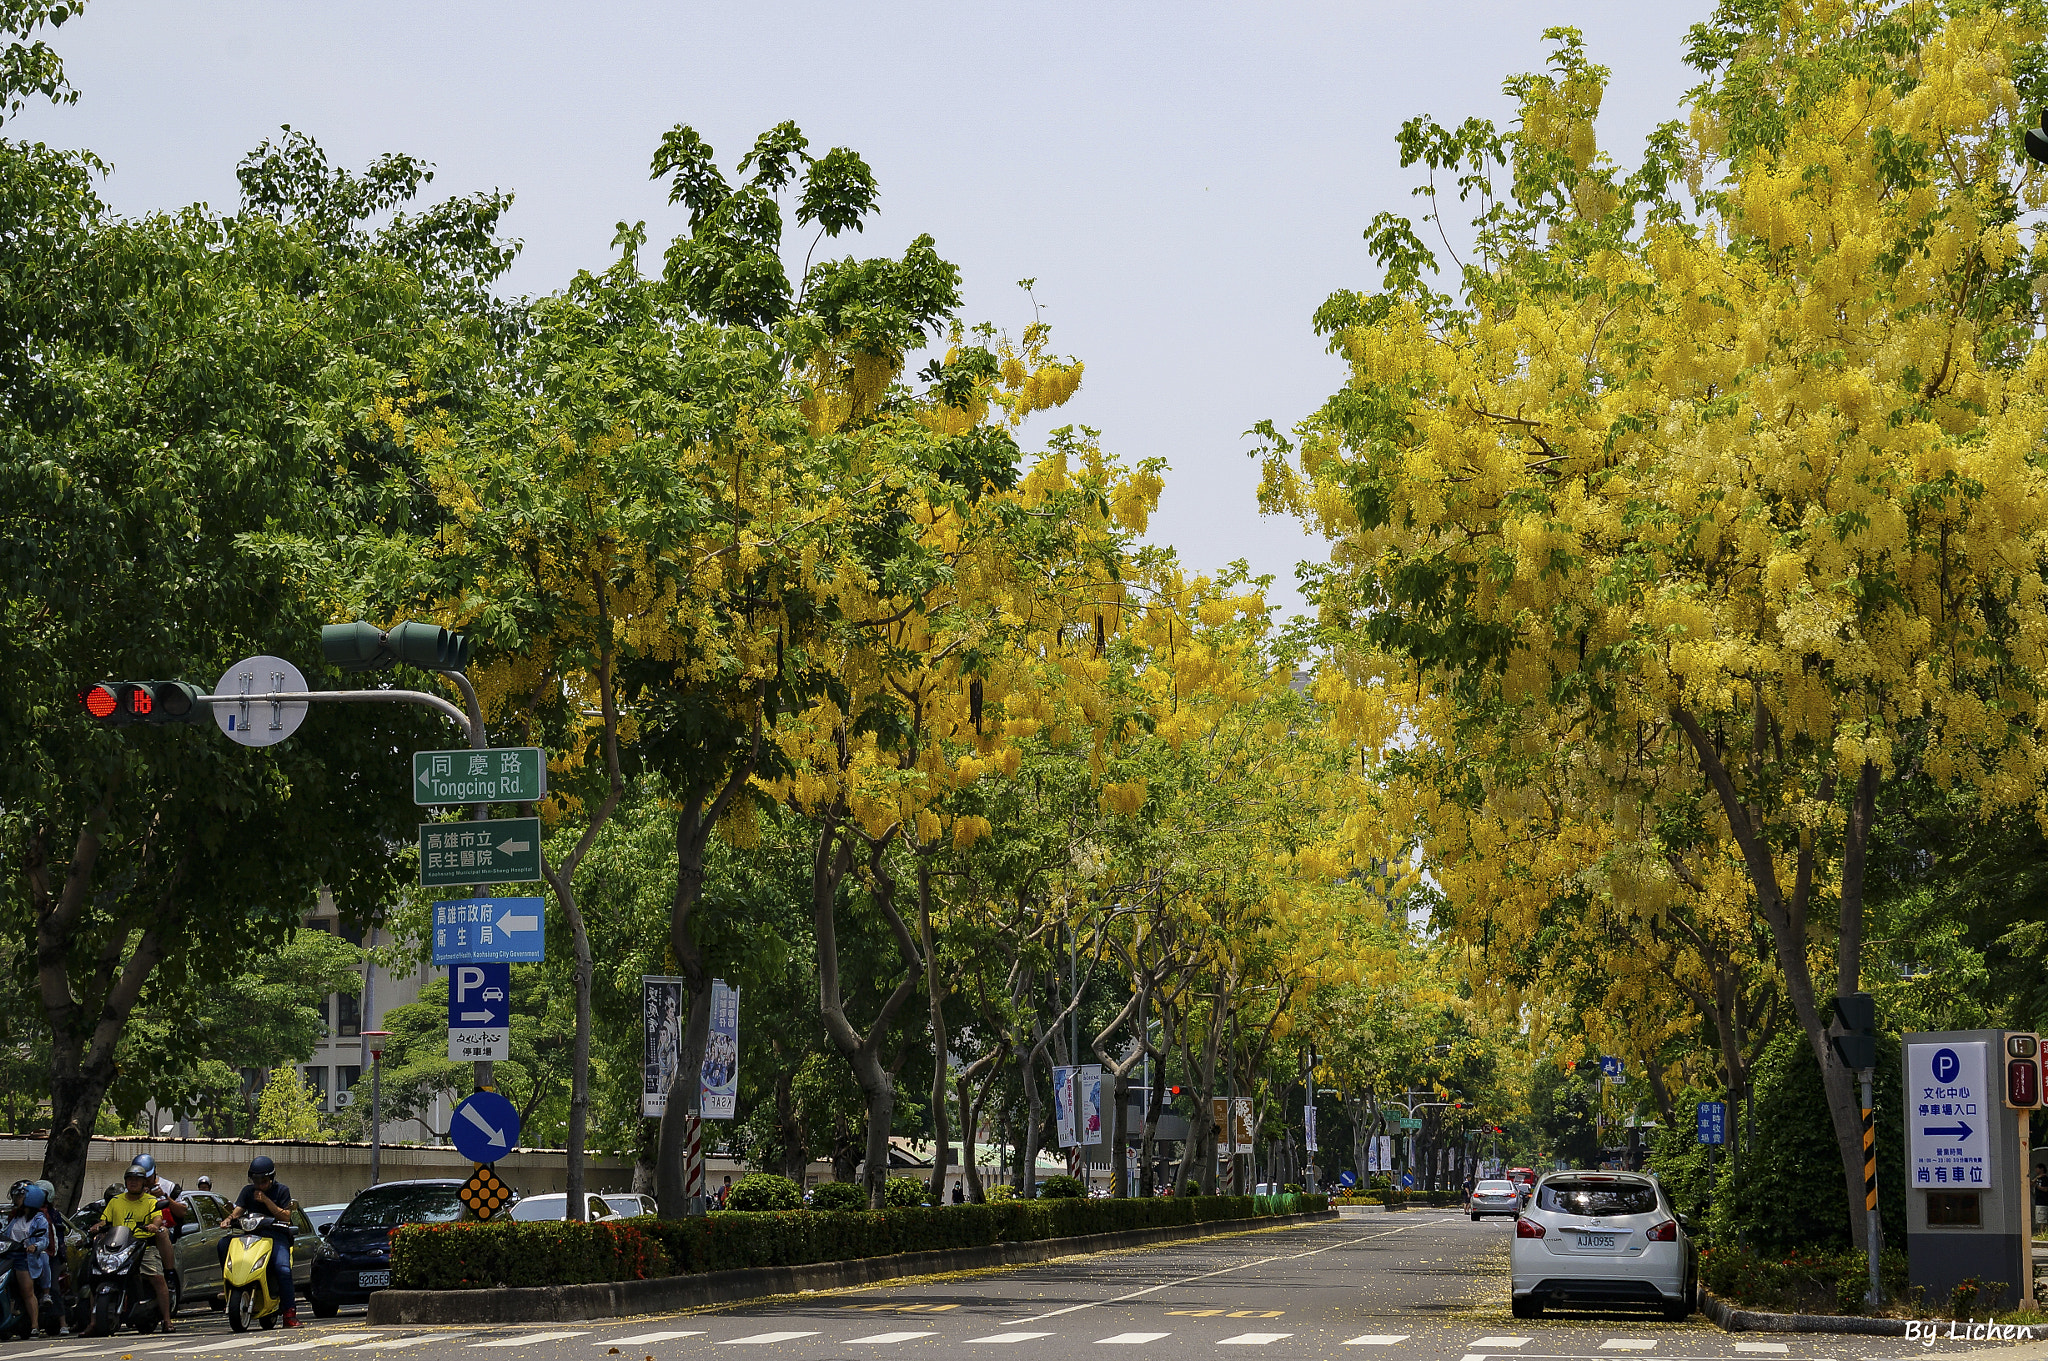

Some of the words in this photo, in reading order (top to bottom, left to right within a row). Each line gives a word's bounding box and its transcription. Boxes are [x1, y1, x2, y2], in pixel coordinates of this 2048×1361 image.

[431, 751, 522, 777] 同慶路
[431, 778, 496, 800] Tongcing
[500, 776, 524, 794] Rd.
[427, 830, 493, 850] 高雄市立
[428, 850, 493, 869] 民生醫院
[437, 903, 493, 926] 高雄市政府
[437, 925, 493, 947] 衛生局
[499, 950, 510, 959] City
[457, 966, 485, 1003] P
[462, 1047, 493, 1057] 停車場
[1939, 1056, 1953, 1078] P
[1923, 1087, 1971, 1099] 文化中心
[1918, 1103, 1977, 1117] 停車場入口
[1917, 1166, 1983, 1183] 尚有車位
